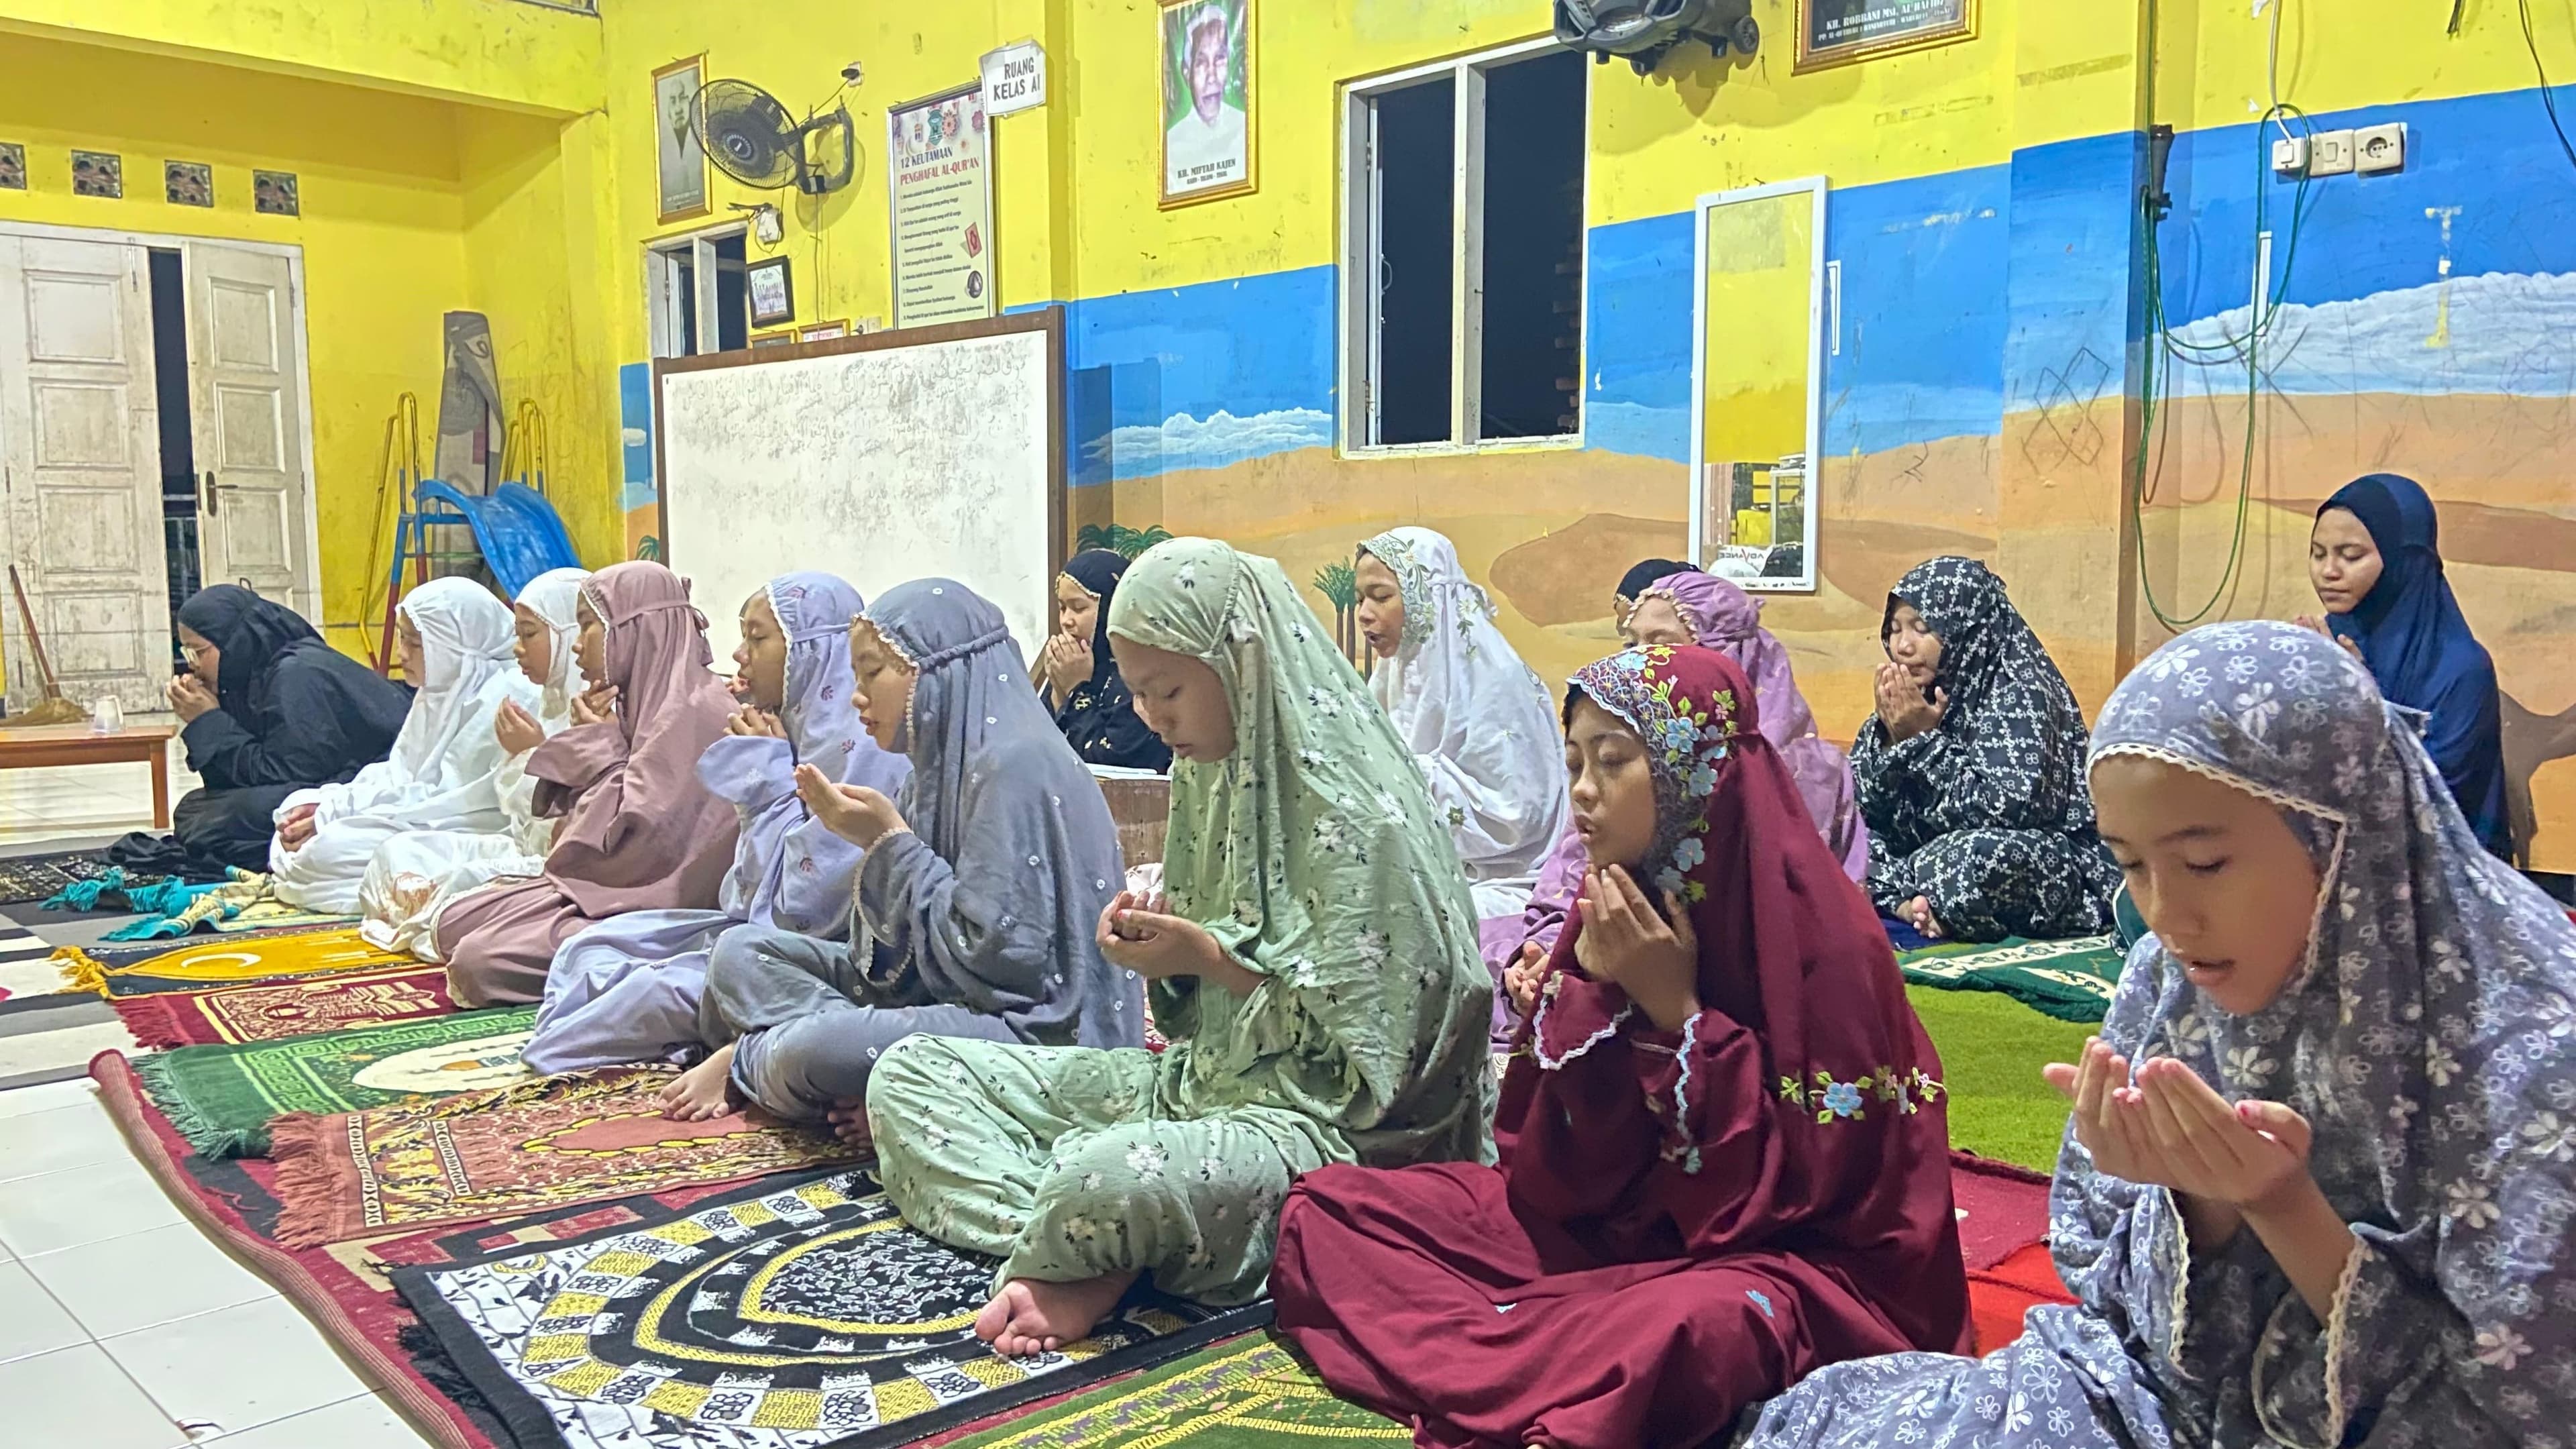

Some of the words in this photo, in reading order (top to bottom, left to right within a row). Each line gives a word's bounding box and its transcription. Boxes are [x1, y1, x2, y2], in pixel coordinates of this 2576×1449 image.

[1004, 56, 1034, 80] RUANG
[994, 78, 1025, 101] KELAS
[901, 156, 910, 169] 12
[912, 146, 953, 166] KEUTAMAAN
[1191, 162, 1215, 176] MIFTAH
[900, 166, 940, 186] PENGHAFAL
[942, 156, 979, 175] AL-QUR'AN
